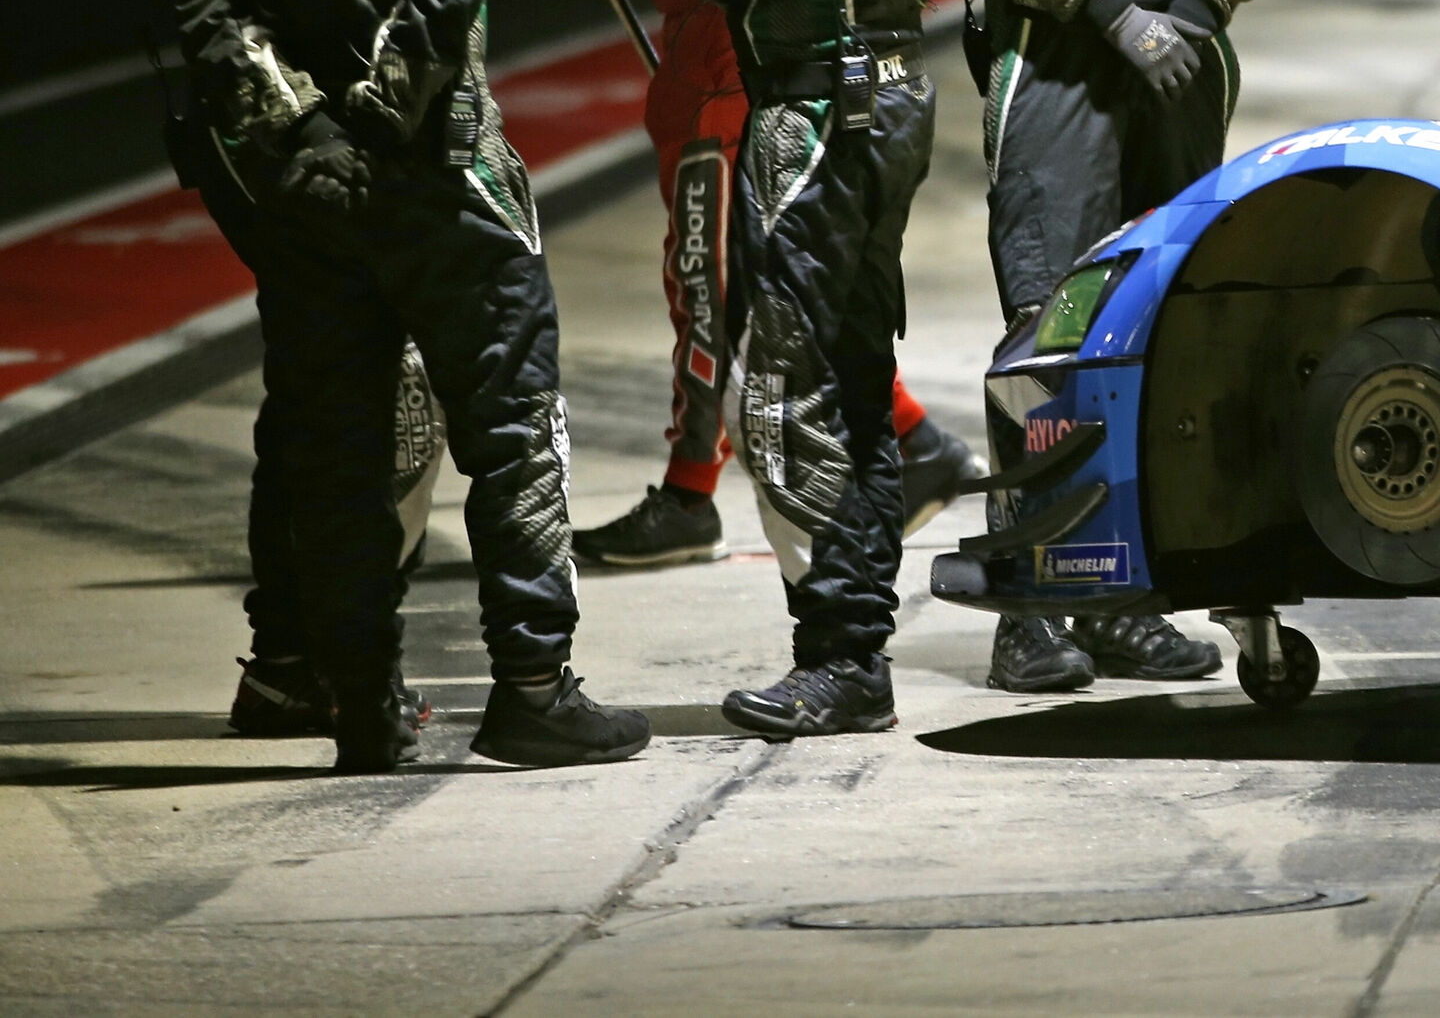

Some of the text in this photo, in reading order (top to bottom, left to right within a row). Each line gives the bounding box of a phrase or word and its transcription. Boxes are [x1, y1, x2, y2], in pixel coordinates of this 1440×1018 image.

[680, 182, 712, 344] Audi Sport
[1056, 557, 1117, 573] MICHELIN
